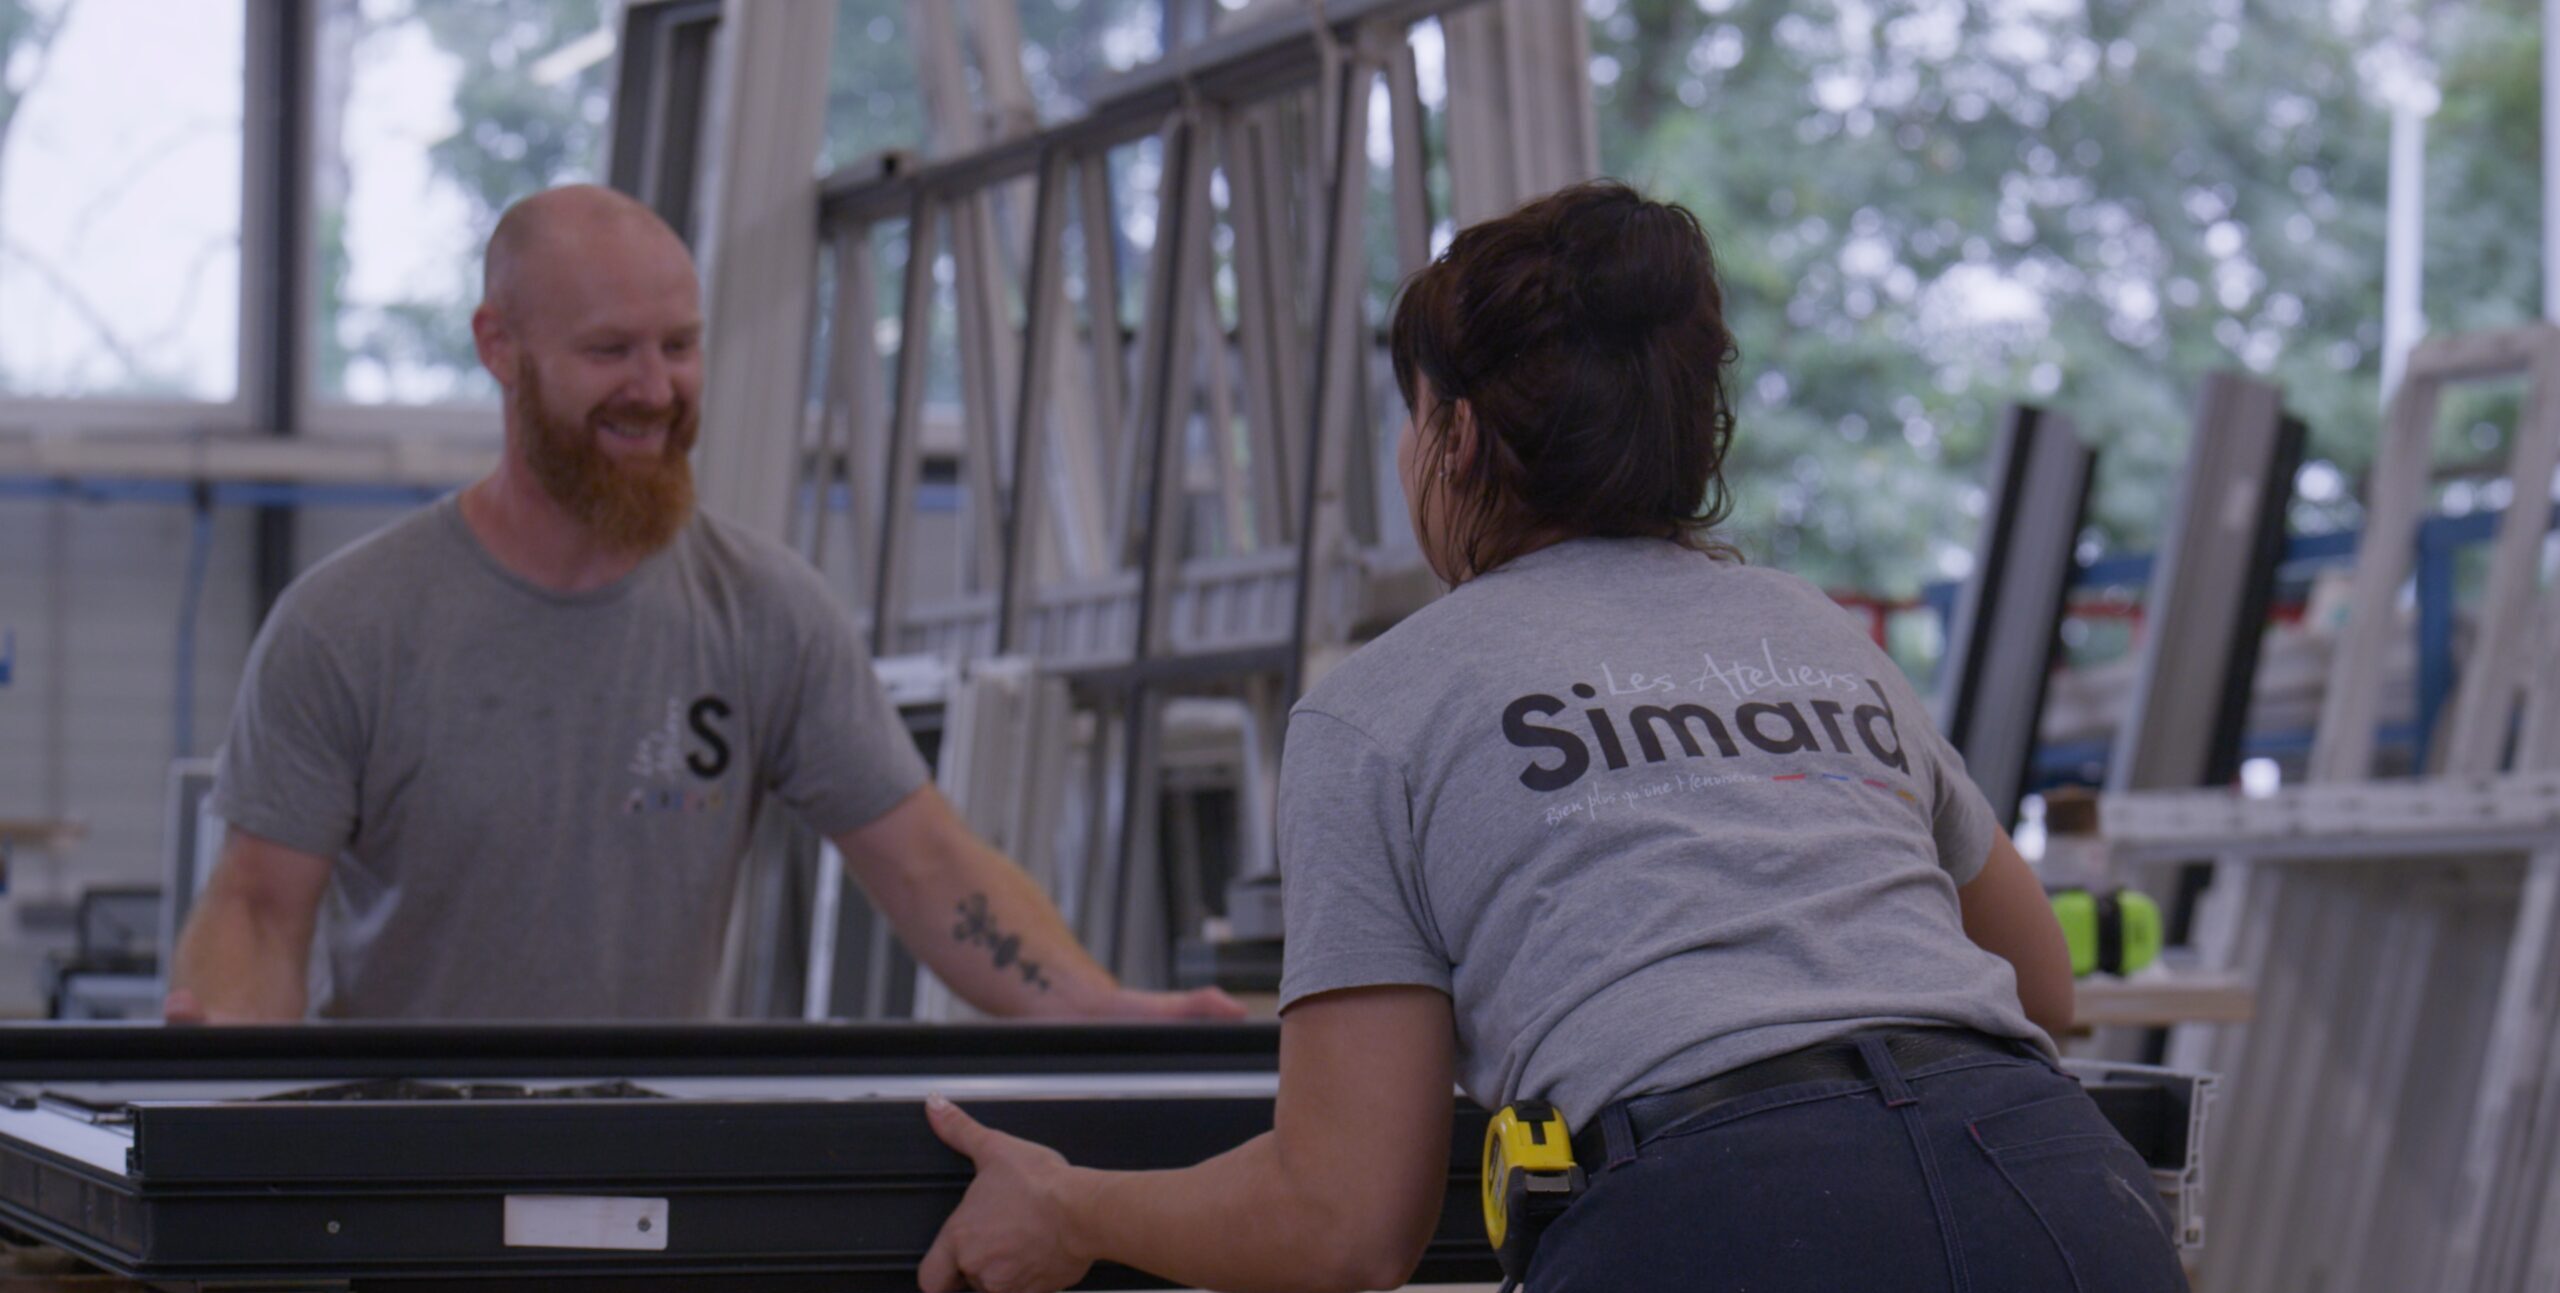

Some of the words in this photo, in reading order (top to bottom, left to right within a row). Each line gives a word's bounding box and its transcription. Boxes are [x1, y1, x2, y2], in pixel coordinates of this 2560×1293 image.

[1602, 661, 1676, 696] Les
[1689, 638, 1859, 701] Ateliers
[687, 697, 731, 780] S
[1502, 679, 1911, 792] Simard
[1543, 802, 1583, 826] Bien
[1588, 781, 1616, 821] plus
